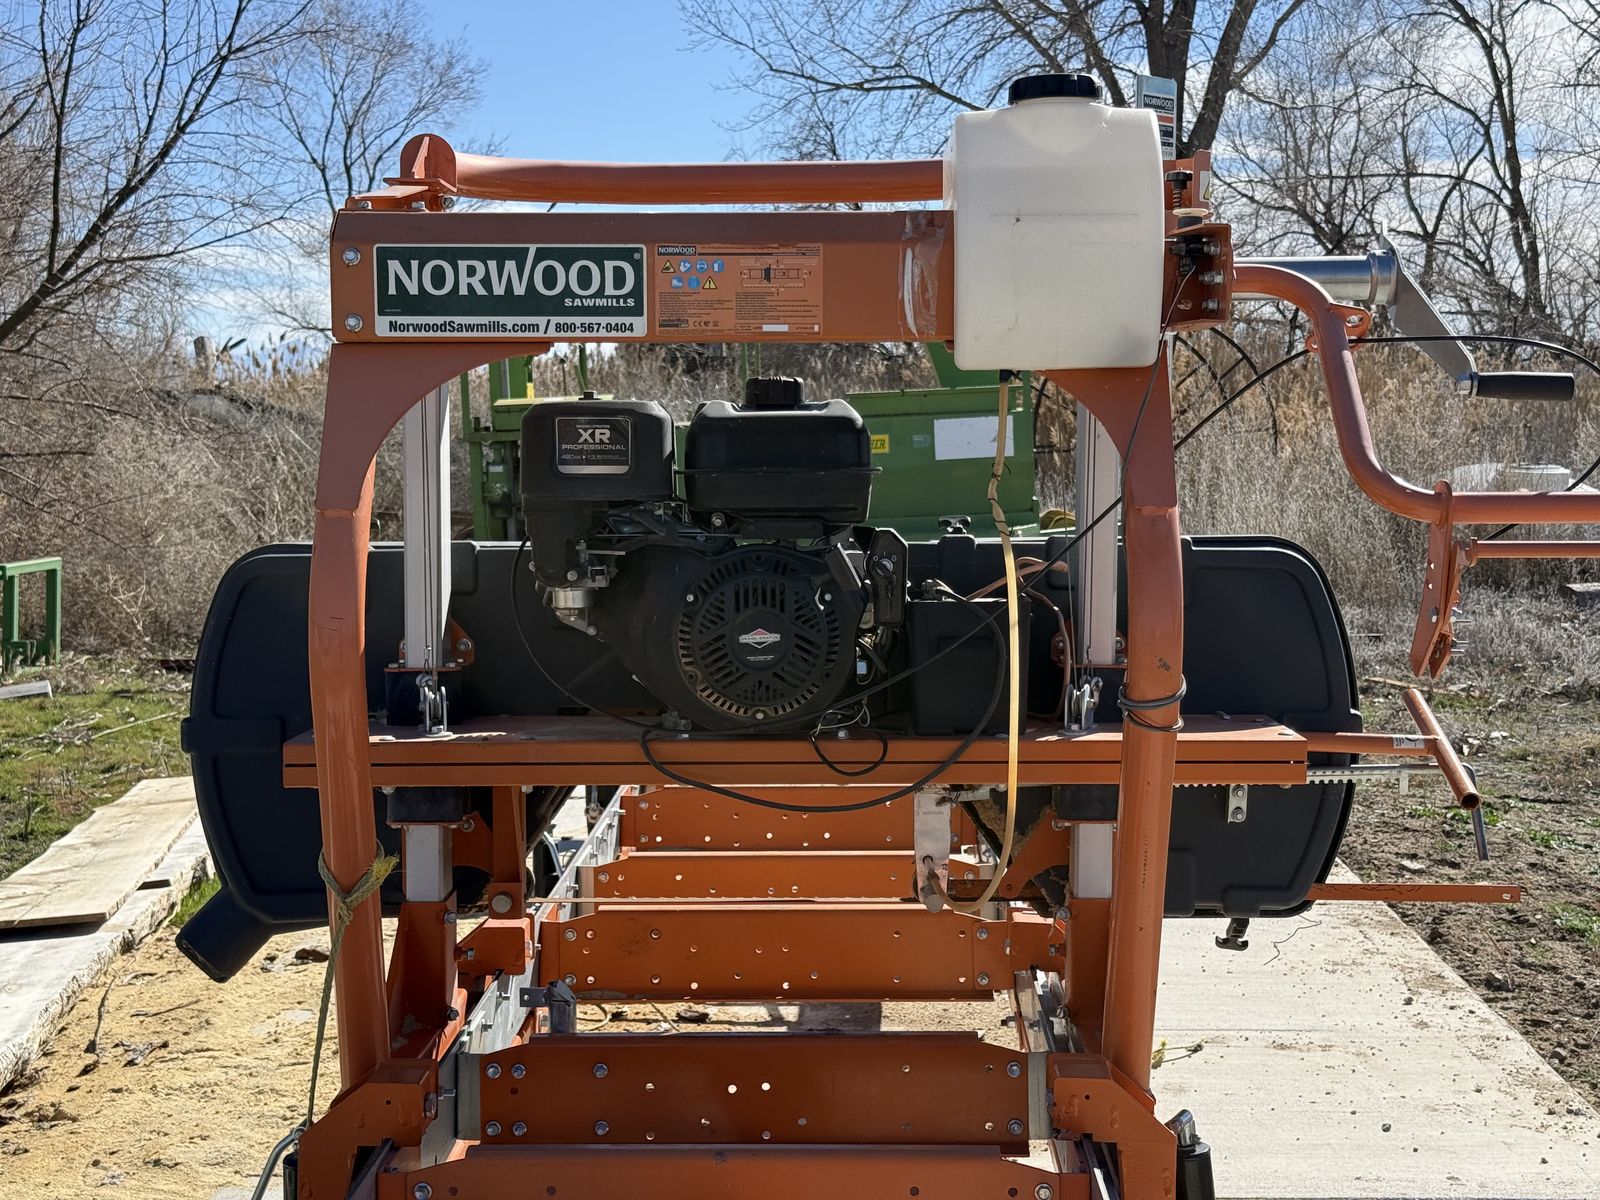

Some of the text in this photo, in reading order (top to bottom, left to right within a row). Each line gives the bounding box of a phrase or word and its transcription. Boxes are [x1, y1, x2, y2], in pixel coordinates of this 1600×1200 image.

[1144, 97, 1174, 108] NORWOOD
[657, 246, 696, 255] NORWOOD
[386, 247, 636, 296] NORWOOD
[564, 298, 636, 308] SAWMILLS
[388, 319, 540, 333] NorwoodSawmills.com
[577, 429, 610, 443] XR
